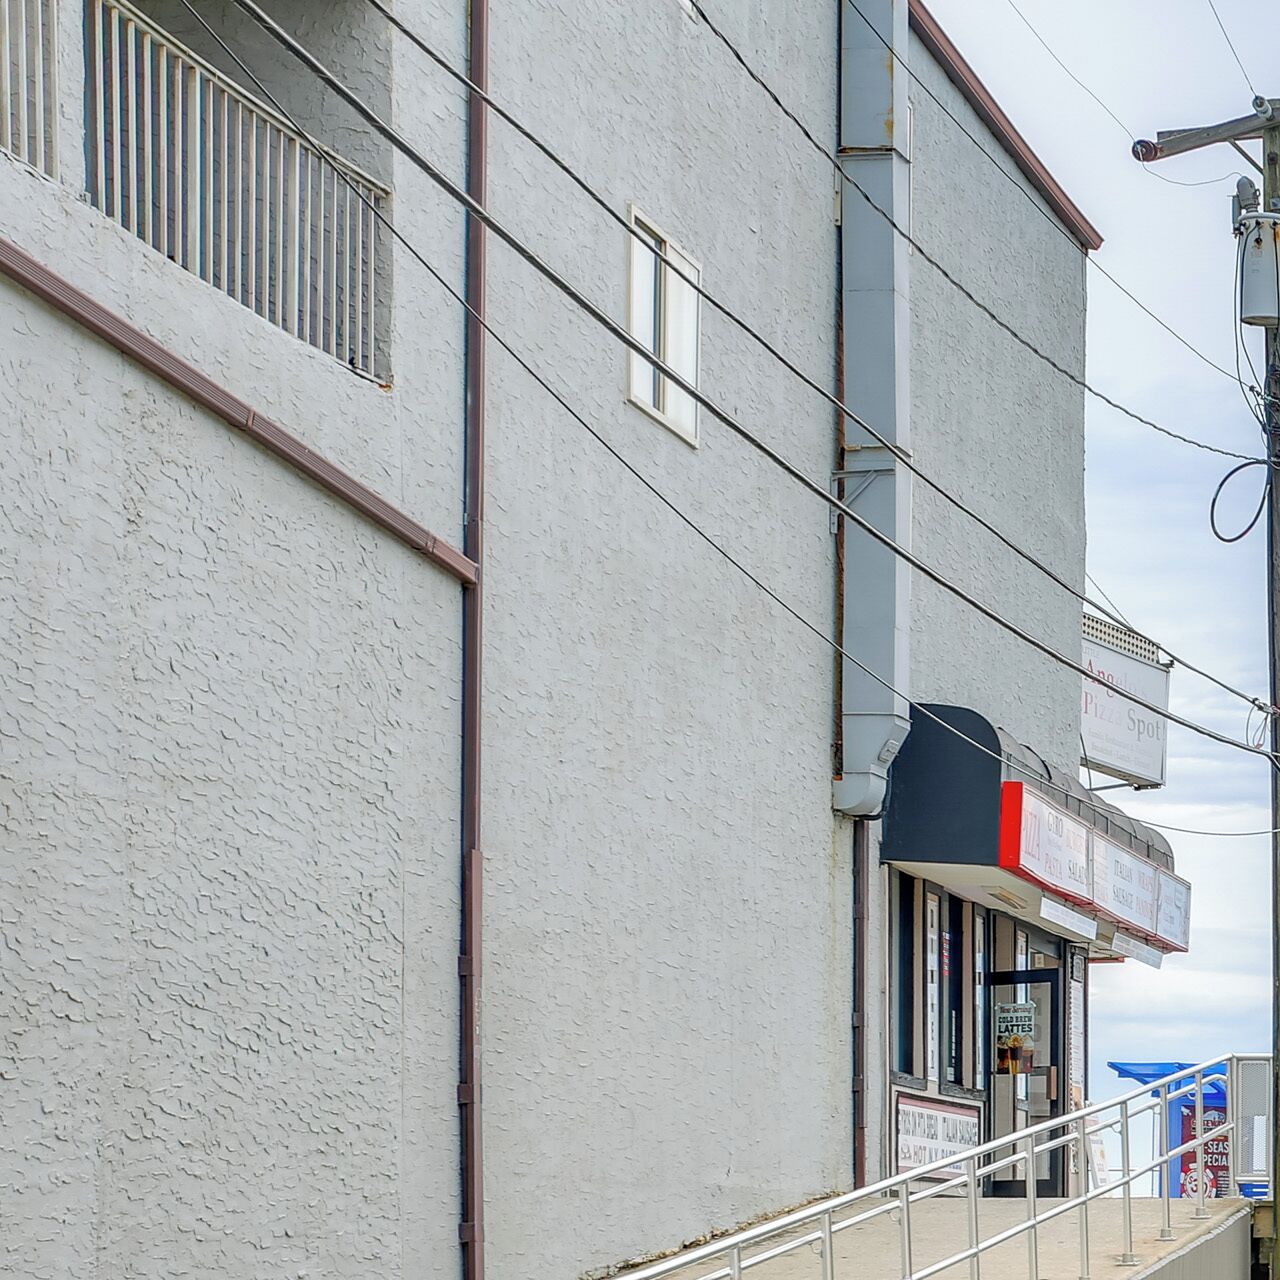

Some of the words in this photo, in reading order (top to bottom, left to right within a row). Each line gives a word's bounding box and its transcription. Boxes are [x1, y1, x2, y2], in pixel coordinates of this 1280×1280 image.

[998, 1016, 1014, 1024] COLD
[1015, 1016, 1032, 1024] BREW
[998, 1024, 1033, 1034] LATTES
[913, 1144, 927, 1165] HOT
